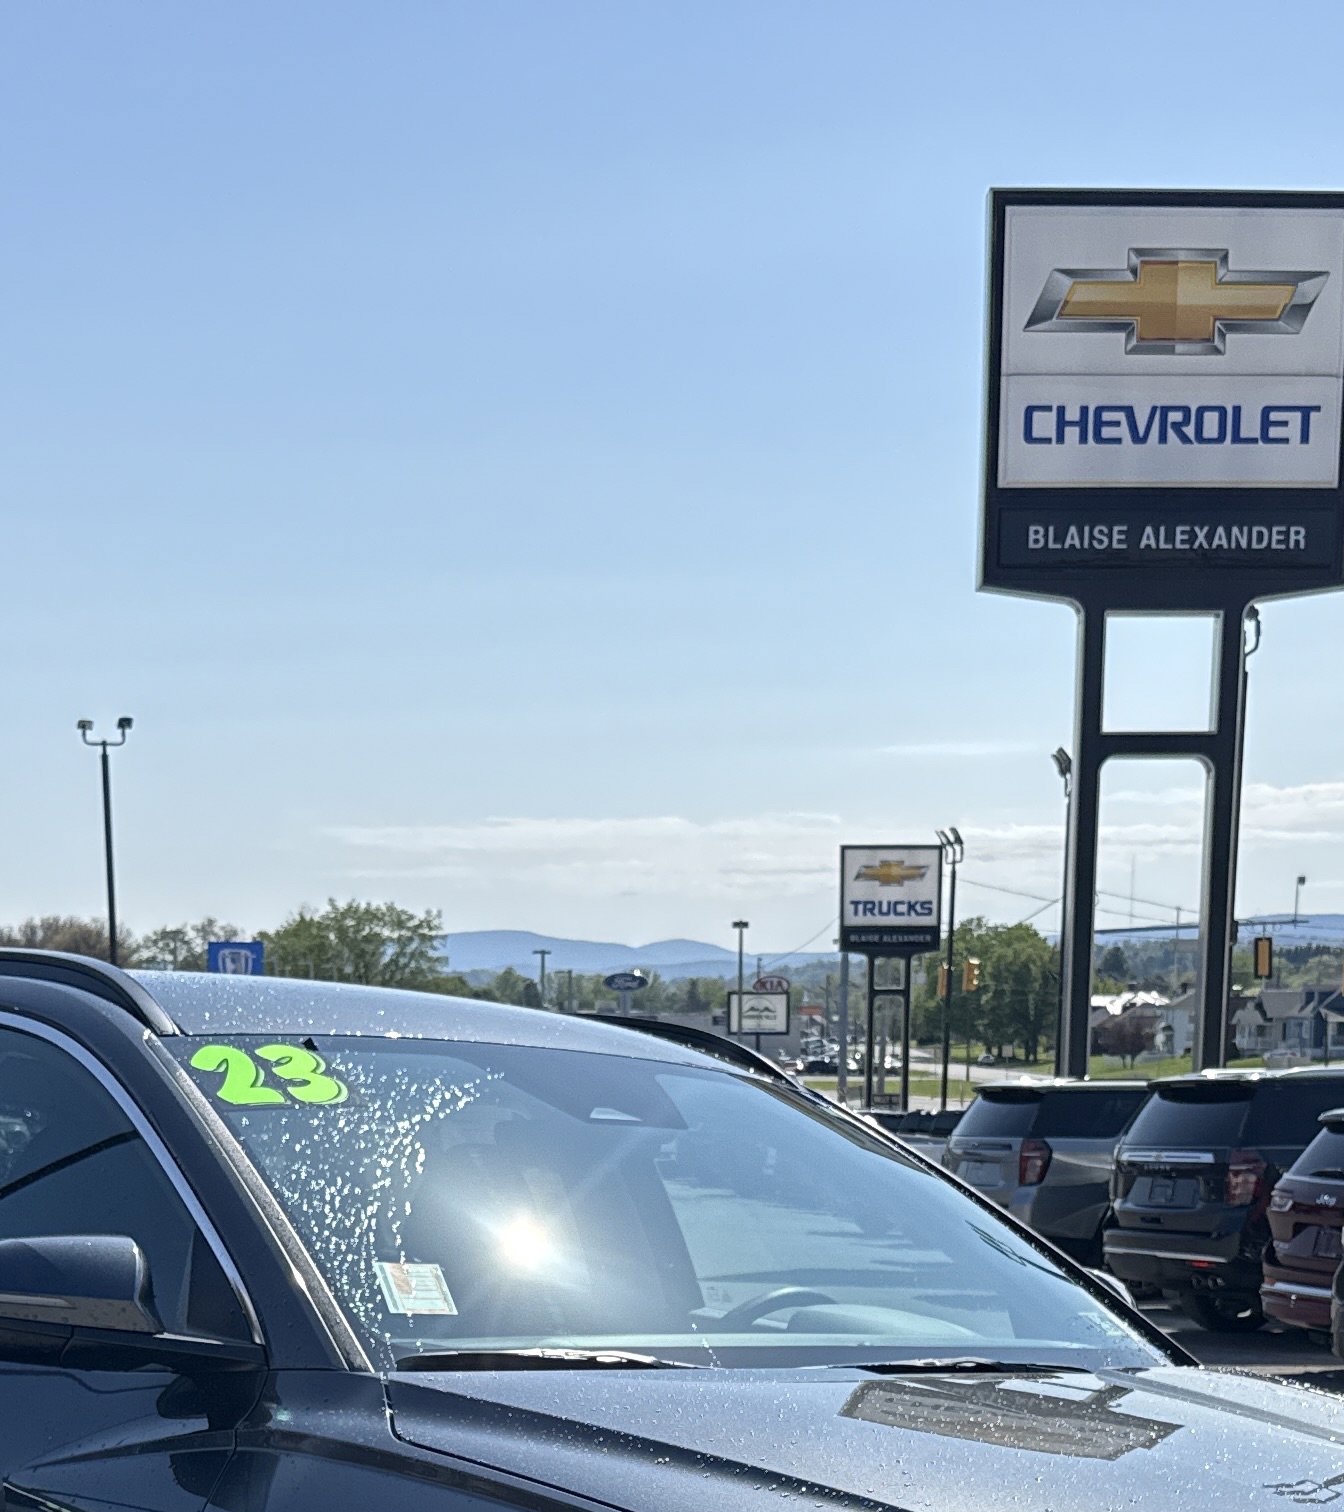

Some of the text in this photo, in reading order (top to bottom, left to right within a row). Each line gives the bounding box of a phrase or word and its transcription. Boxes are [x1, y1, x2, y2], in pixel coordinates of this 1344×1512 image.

[1022, 404, 1322, 445] CHEVROLET
[1027, 524, 1307, 550] BLAISE ALEXANDER
[849, 900, 934, 917] TRUCKS
[190, 1044, 349, 1107] 23
